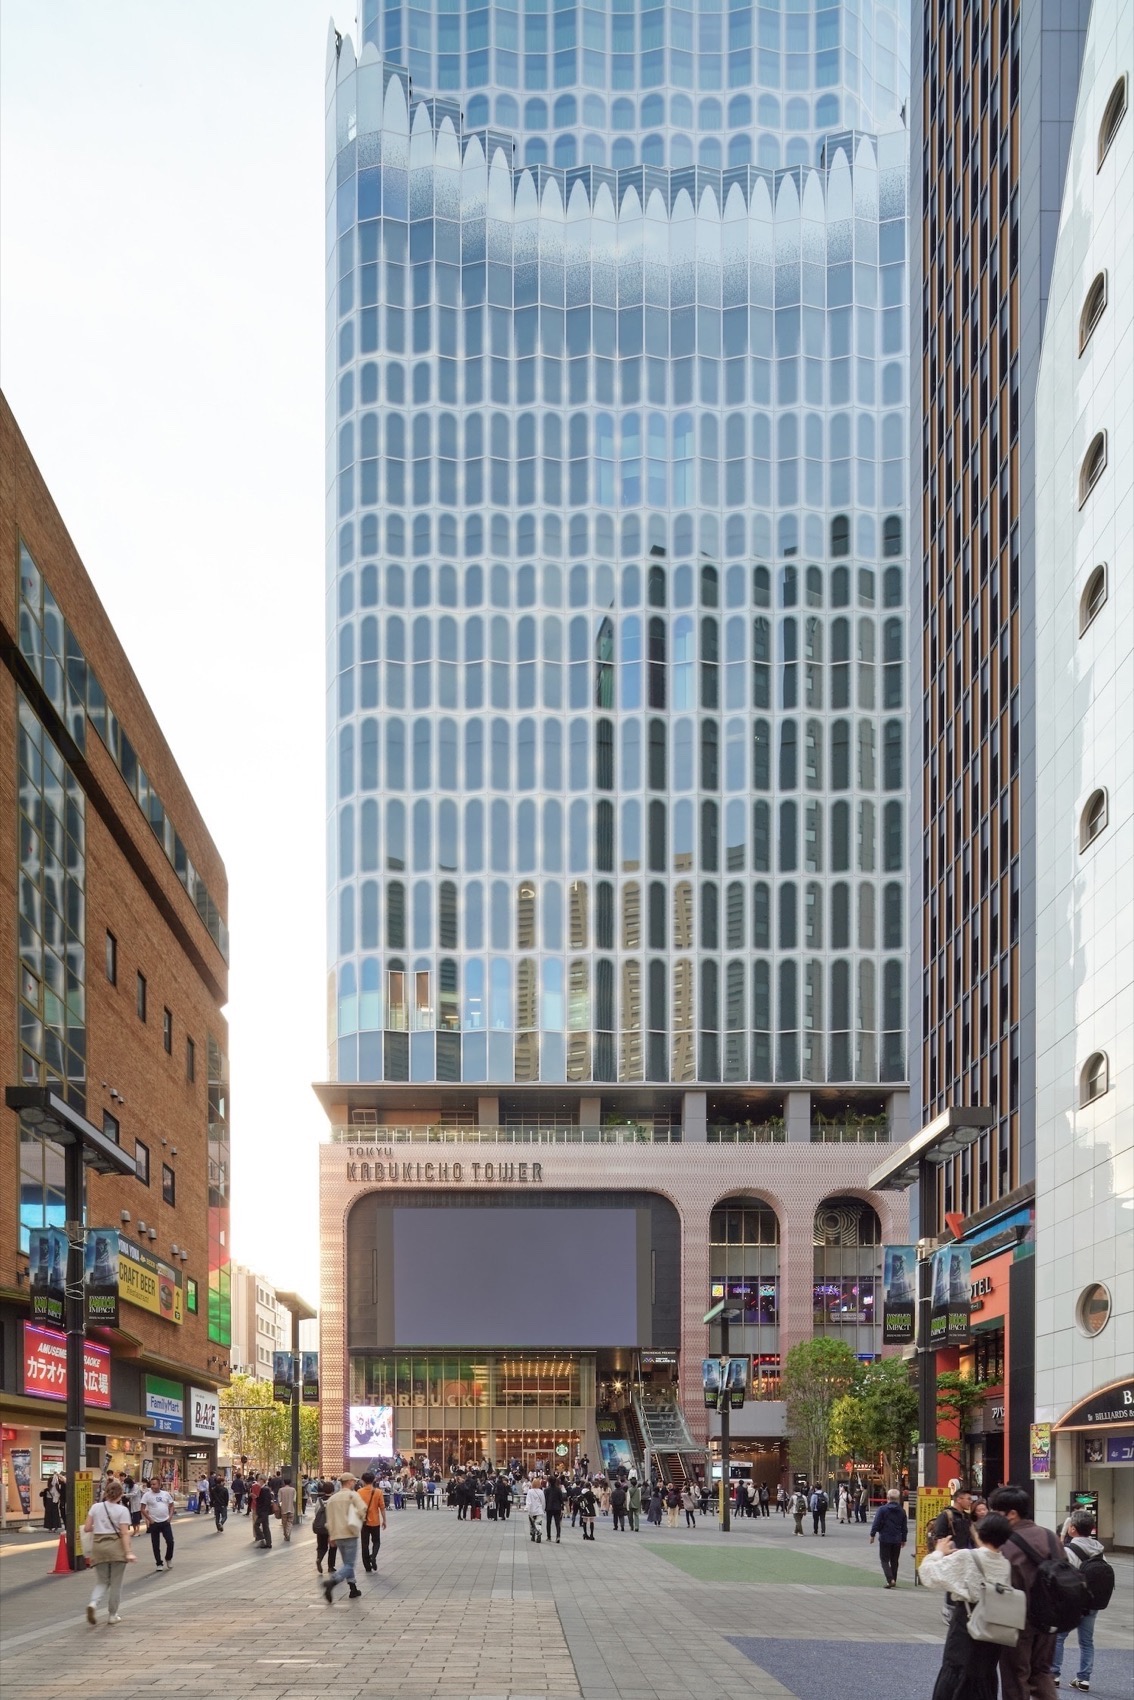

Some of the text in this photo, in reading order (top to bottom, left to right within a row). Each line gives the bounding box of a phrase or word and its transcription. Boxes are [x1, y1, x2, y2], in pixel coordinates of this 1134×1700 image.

[347, 1147, 392, 1157] TOKYU
[346, 1162, 543, 1182] KABUKICHO TOWER
[119, 1262, 156, 1296] CRAFT BEER
[88, 1306, 116, 1314] IMPACT
[38, 1343, 101, 1368] AMUSEME RAOKE
[27, 1356, 67, 1384] カラオケ
[150, 1396, 180, 1414] FamilyMart
[352, 1394, 489, 1407] STARBUCKS
[1123, 1390, 1134, 1405] B
[1095, 1410, 1128, 1421] BILLIARDS
